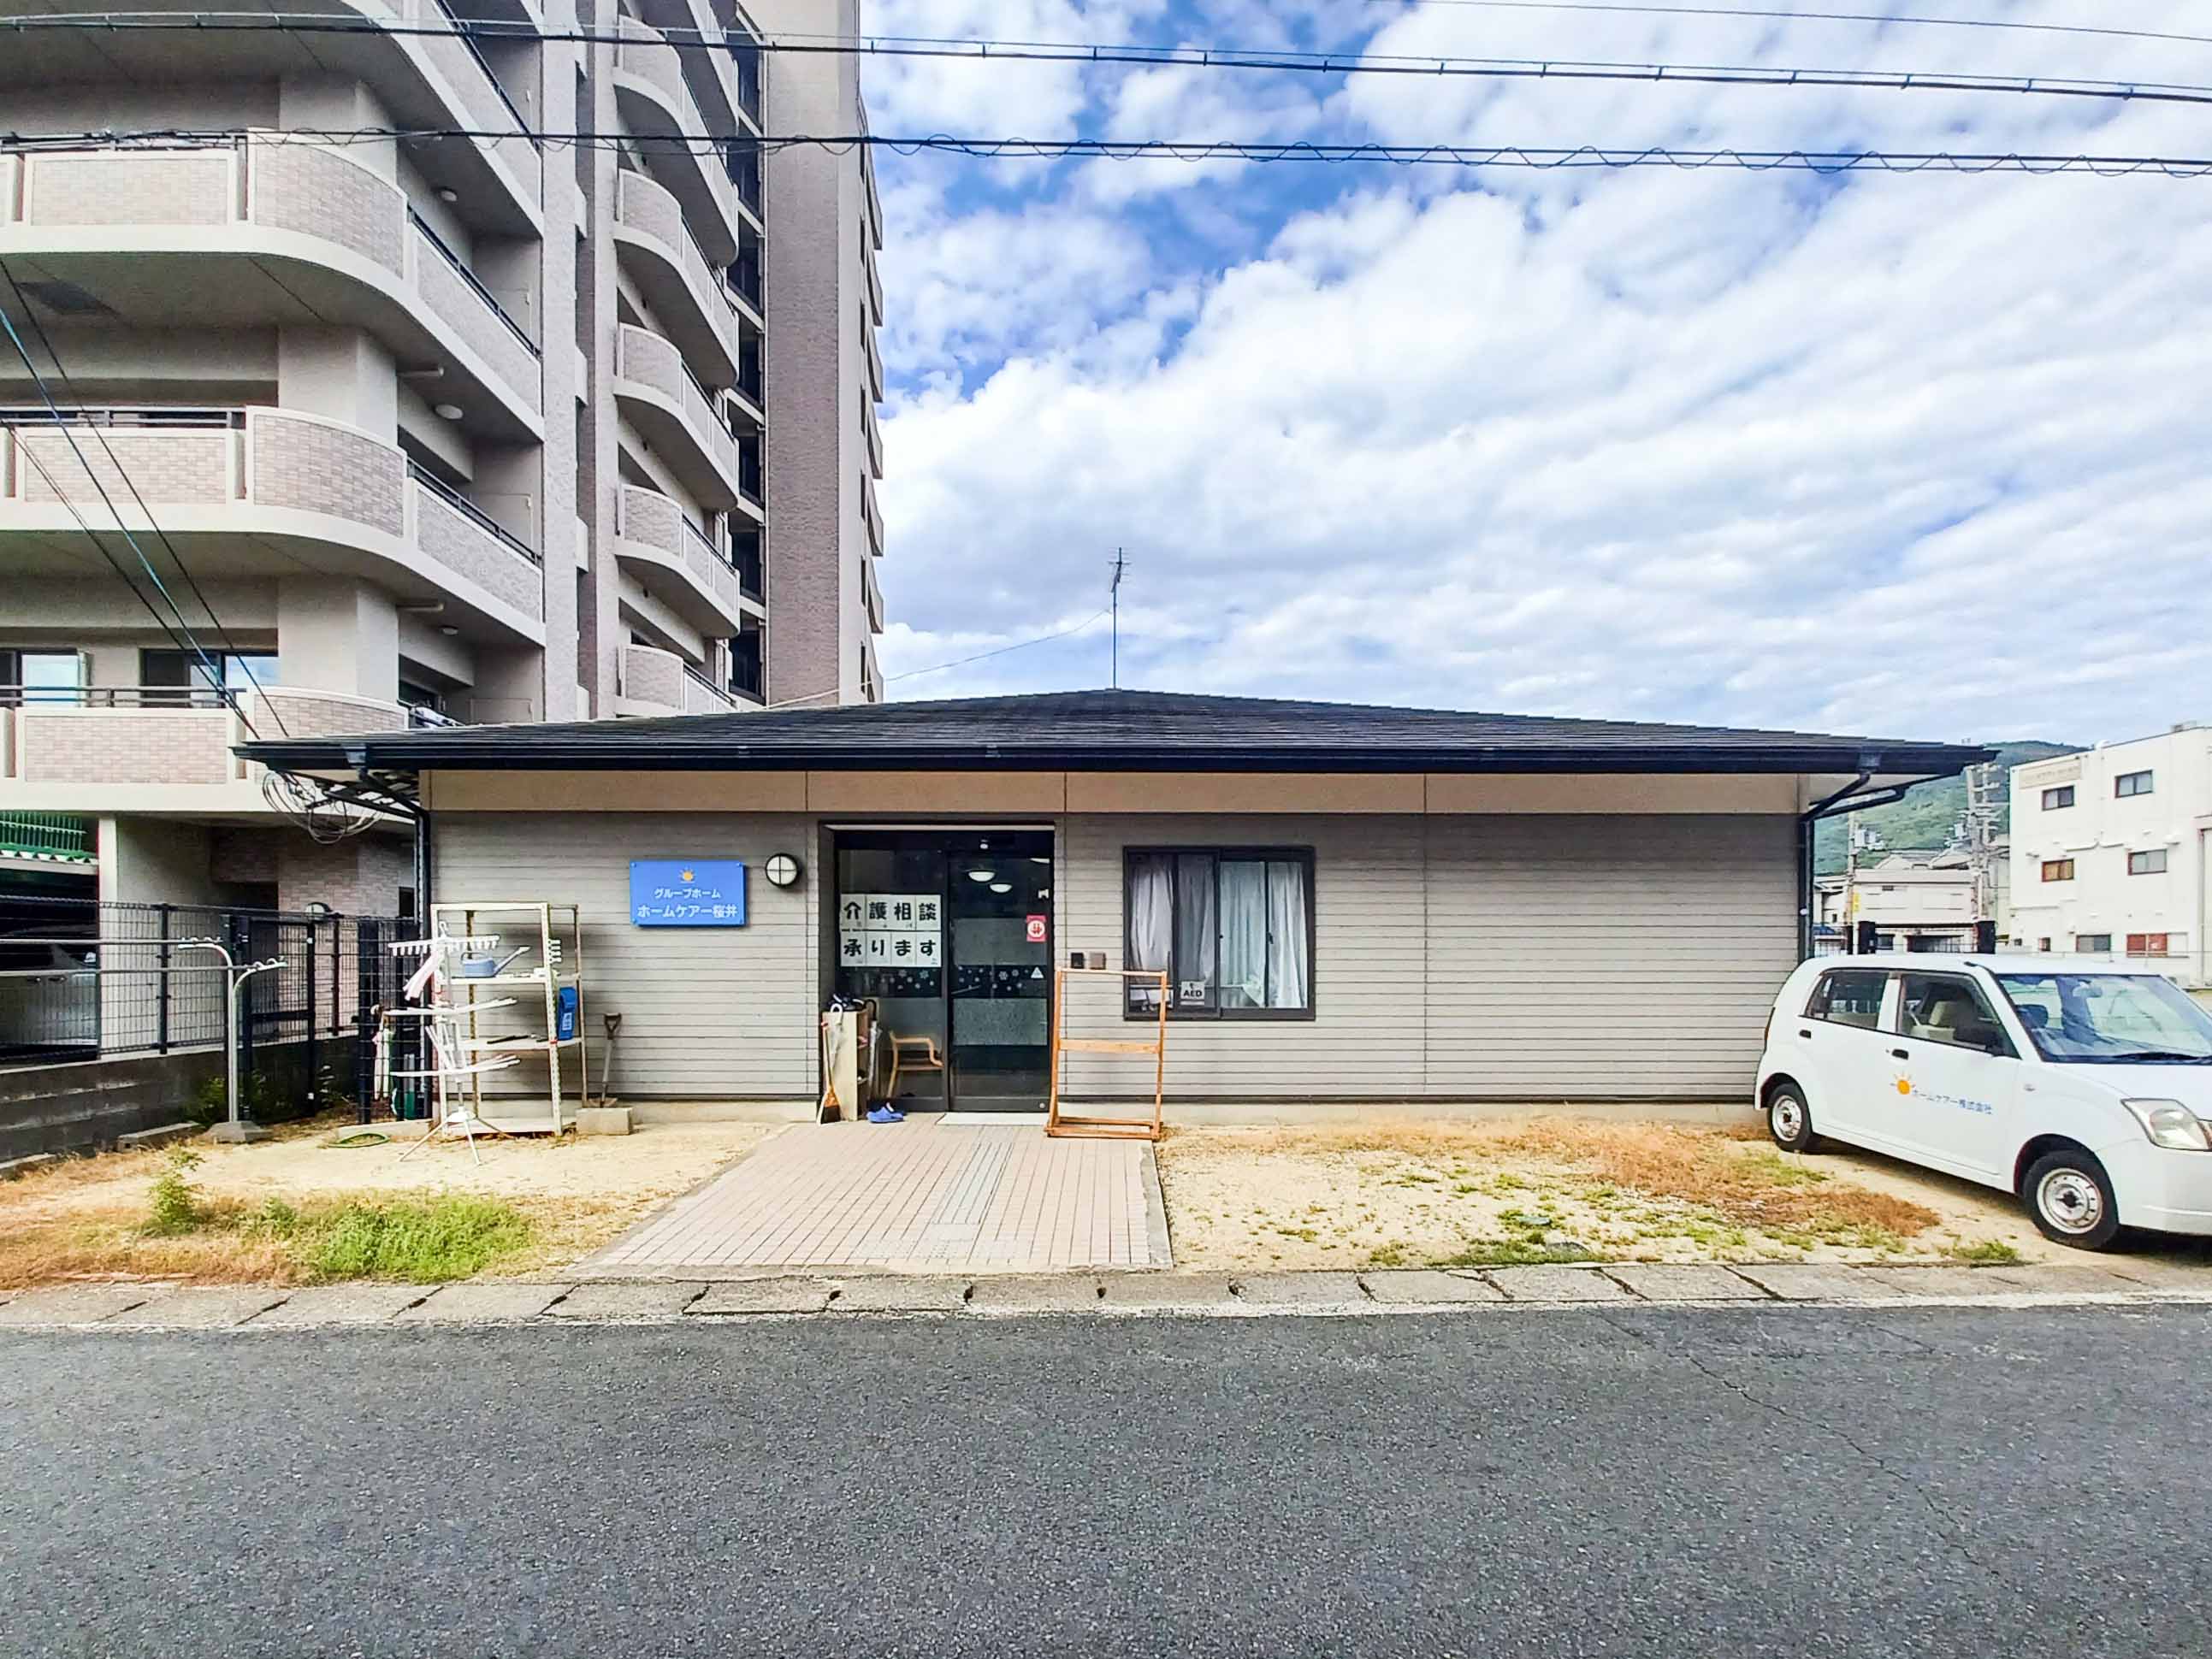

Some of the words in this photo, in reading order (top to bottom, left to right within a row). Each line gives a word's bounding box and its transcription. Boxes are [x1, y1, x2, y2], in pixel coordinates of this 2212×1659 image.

[654, 887, 721, 899] グループホーム
[636, 904, 737, 918] ホームケアー桜井
[843, 900, 937, 922] 介護相談
[843, 937, 937, 957] 承ります
[1183, 989, 1203, 998] AED
